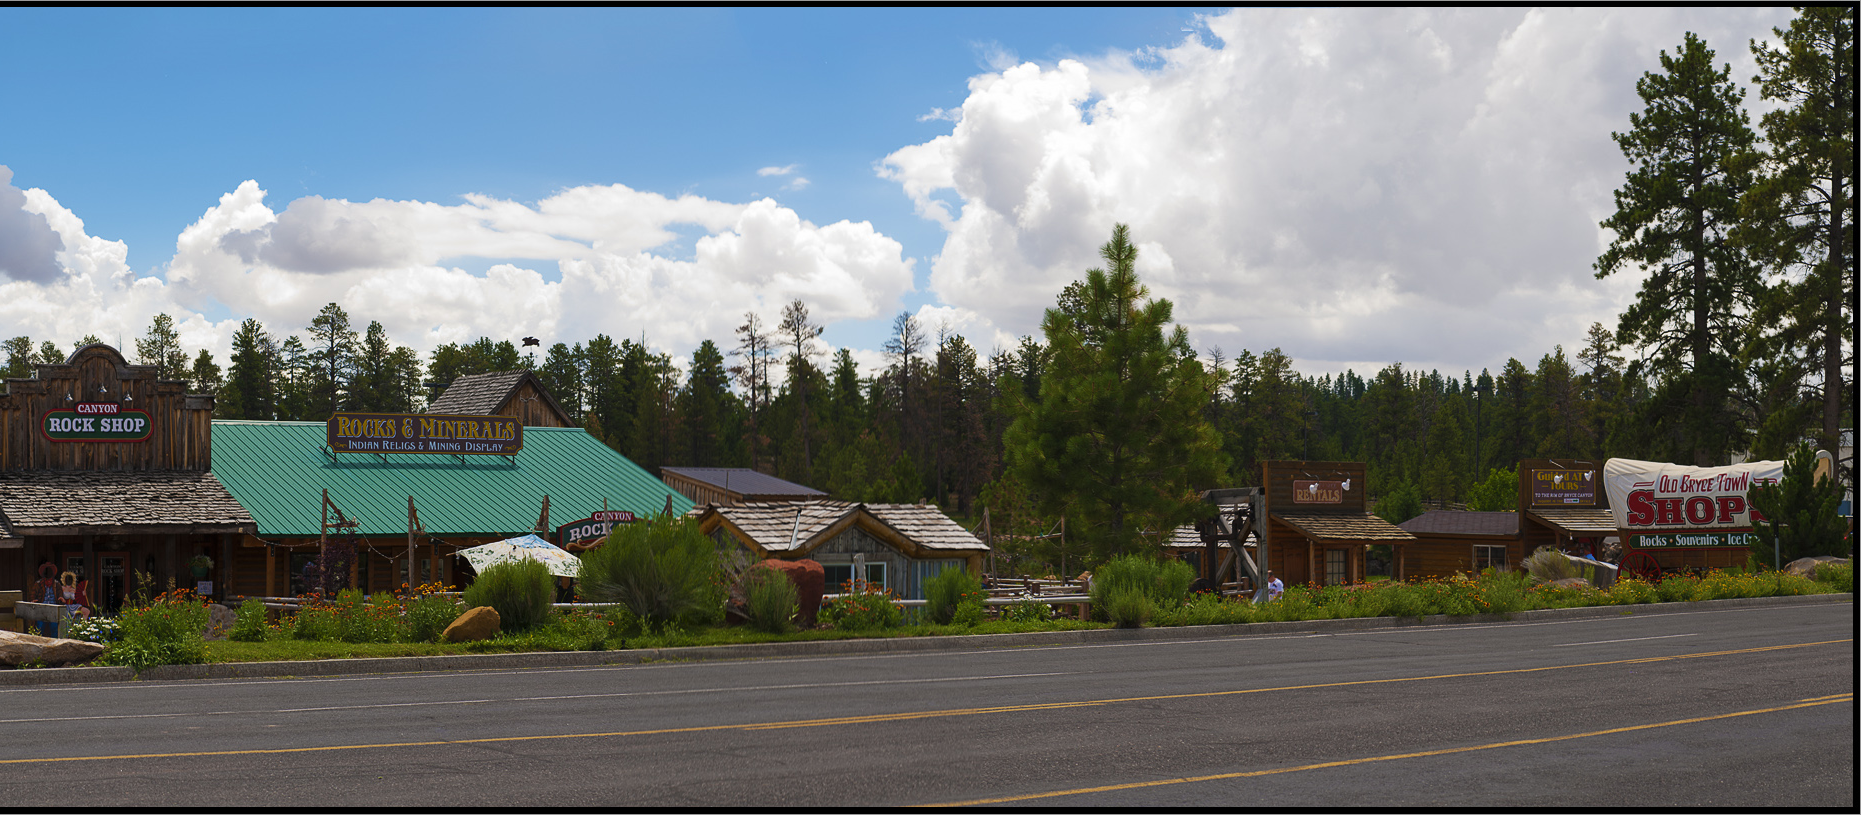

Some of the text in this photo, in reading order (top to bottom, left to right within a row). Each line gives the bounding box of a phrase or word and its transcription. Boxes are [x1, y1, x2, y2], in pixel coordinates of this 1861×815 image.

[78, 404, 118, 413] CANYON
[49, 418, 145, 432] ROCK SHOP
[336, 416, 515, 441] ROCKS & MINERALS
[348, 440, 379, 450] INDIAN
[428, 441, 461, 451] MINING
[465, 442, 503, 452] DISPLAY
[1550, 482, 1579, 490] TOURS
[1659, 472, 1749, 493] OLD BRYCE TOWN
[1296, 489, 1340, 502] RENTALS
[1640, 535, 1667, 547] Rocks
[1676, 534, 1719, 546] Souvenirs
[1727, 534, 1742, 545] Ice
